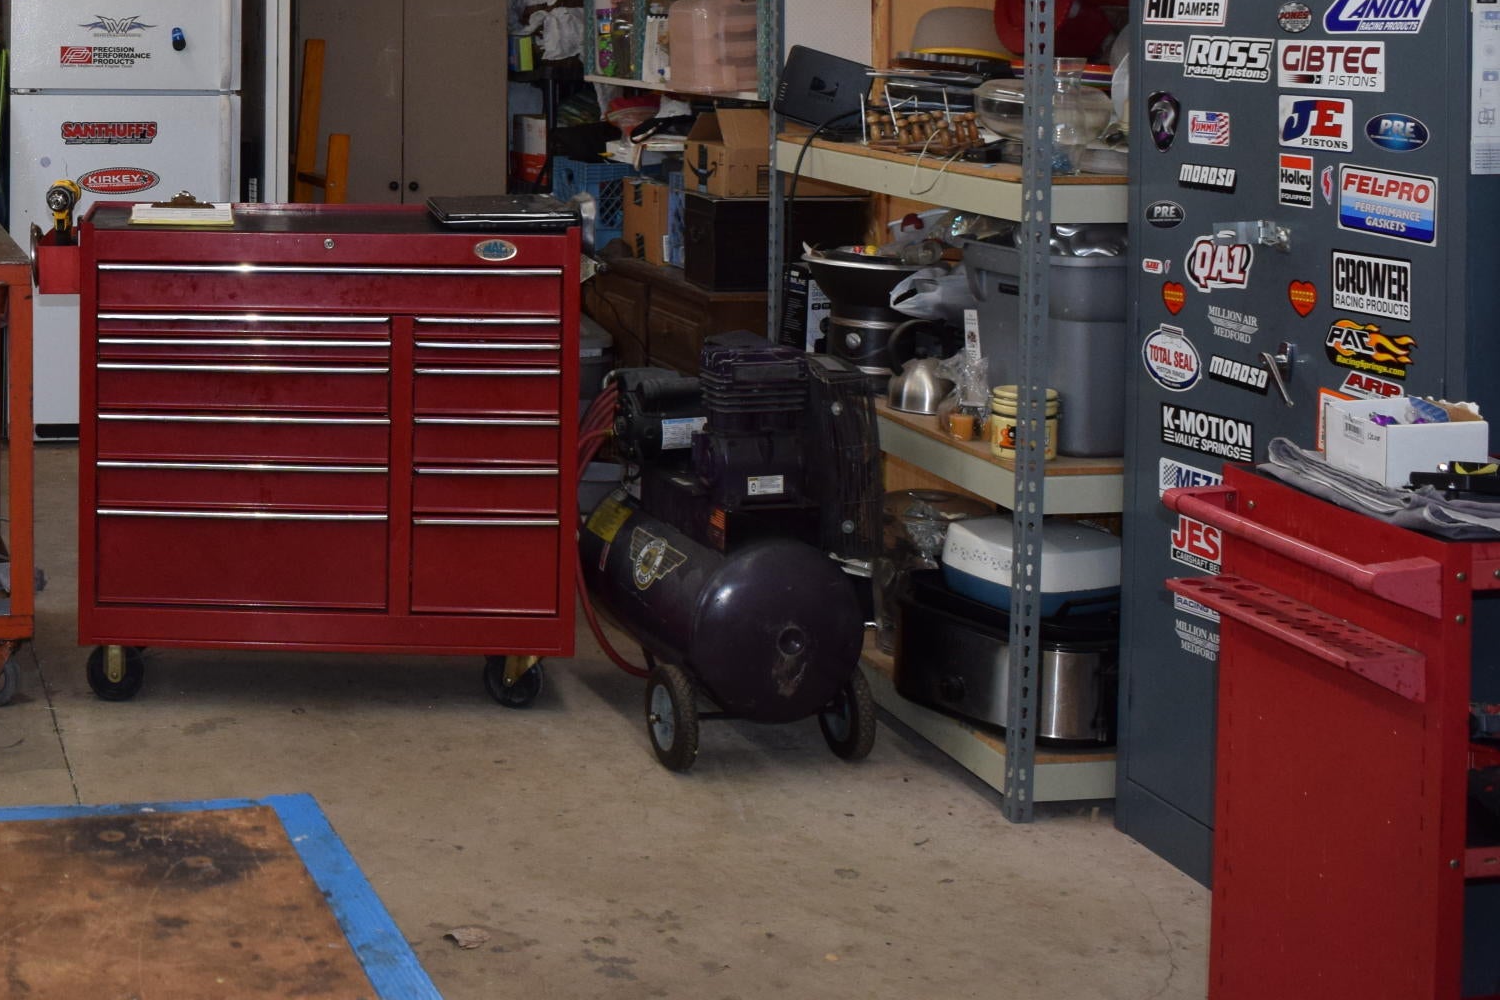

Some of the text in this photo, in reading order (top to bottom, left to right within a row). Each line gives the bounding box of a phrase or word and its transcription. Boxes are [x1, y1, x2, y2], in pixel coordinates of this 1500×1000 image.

[1178, 2, 1220, 16] DAMPER
[1359, 20, 1419, 32] RACING PRODUCTS
[1147, 43, 1182, 56] GIBTEC
[1187, 39, 1272, 68] ROSS
[1282, 45, 1381, 75] GIBTEC
[1187, 65, 1268, 80] racing pistons
[1328, 75, 1377, 87] PISTONS
[63, 123, 157, 139] SANTHUFF'S
[1191, 117, 1219, 134] SUMMIT
[1283, 100, 1345, 142] JE
[1379, 119, 1416, 138] PRE
[1301, 137, 1349, 149] PISTONS
[88, 174, 140, 184] KIRKEY
[1179, 163, 1236, 187] MOROSO
[1280, 169, 1312, 190] Holley
[1281, 193, 1311, 202] EQUIPPED
[1342, 173, 1430, 204] FEL-PRO
[1153, 206, 1176, 218] PRE
[1354, 201, 1421, 222] PERFORMANCE
[1364, 216, 1407, 233] GASKETS
[1193, 242, 1246, 287] QA1
[1335, 257, 1409, 303] CROWER
[1208, 305, 1258, 327] MILLION AIR
[1335, 293, 1364, 309] RACING
[1365, 298, 1409, 317] PRODUCTS
[1213, 325, 1251, 345] MEDFORD
[1327, 327, 1376, 352] PAC
[1149, 344, 1194, 372] TOTAL SEAL
[1335, 354, 1406, 377] RacingSprings.com
[1209, 355, 1269, 389] MOROSO
[1346, 373, 1401, 397] ARP
[1162, 405, 1252, 448] K-MOTION
[1173, 431, 1241, 460] VALVE SPRINGS
[1172, 517, 1220, 562] JES
[1175, 550, 1207, 568] CAMSHAFT
[1176, 596, 1209, 613] RACING
[1175, 618, 1207, 641] MILLION
[1180, 640, 1217, 662] MEDFORD
